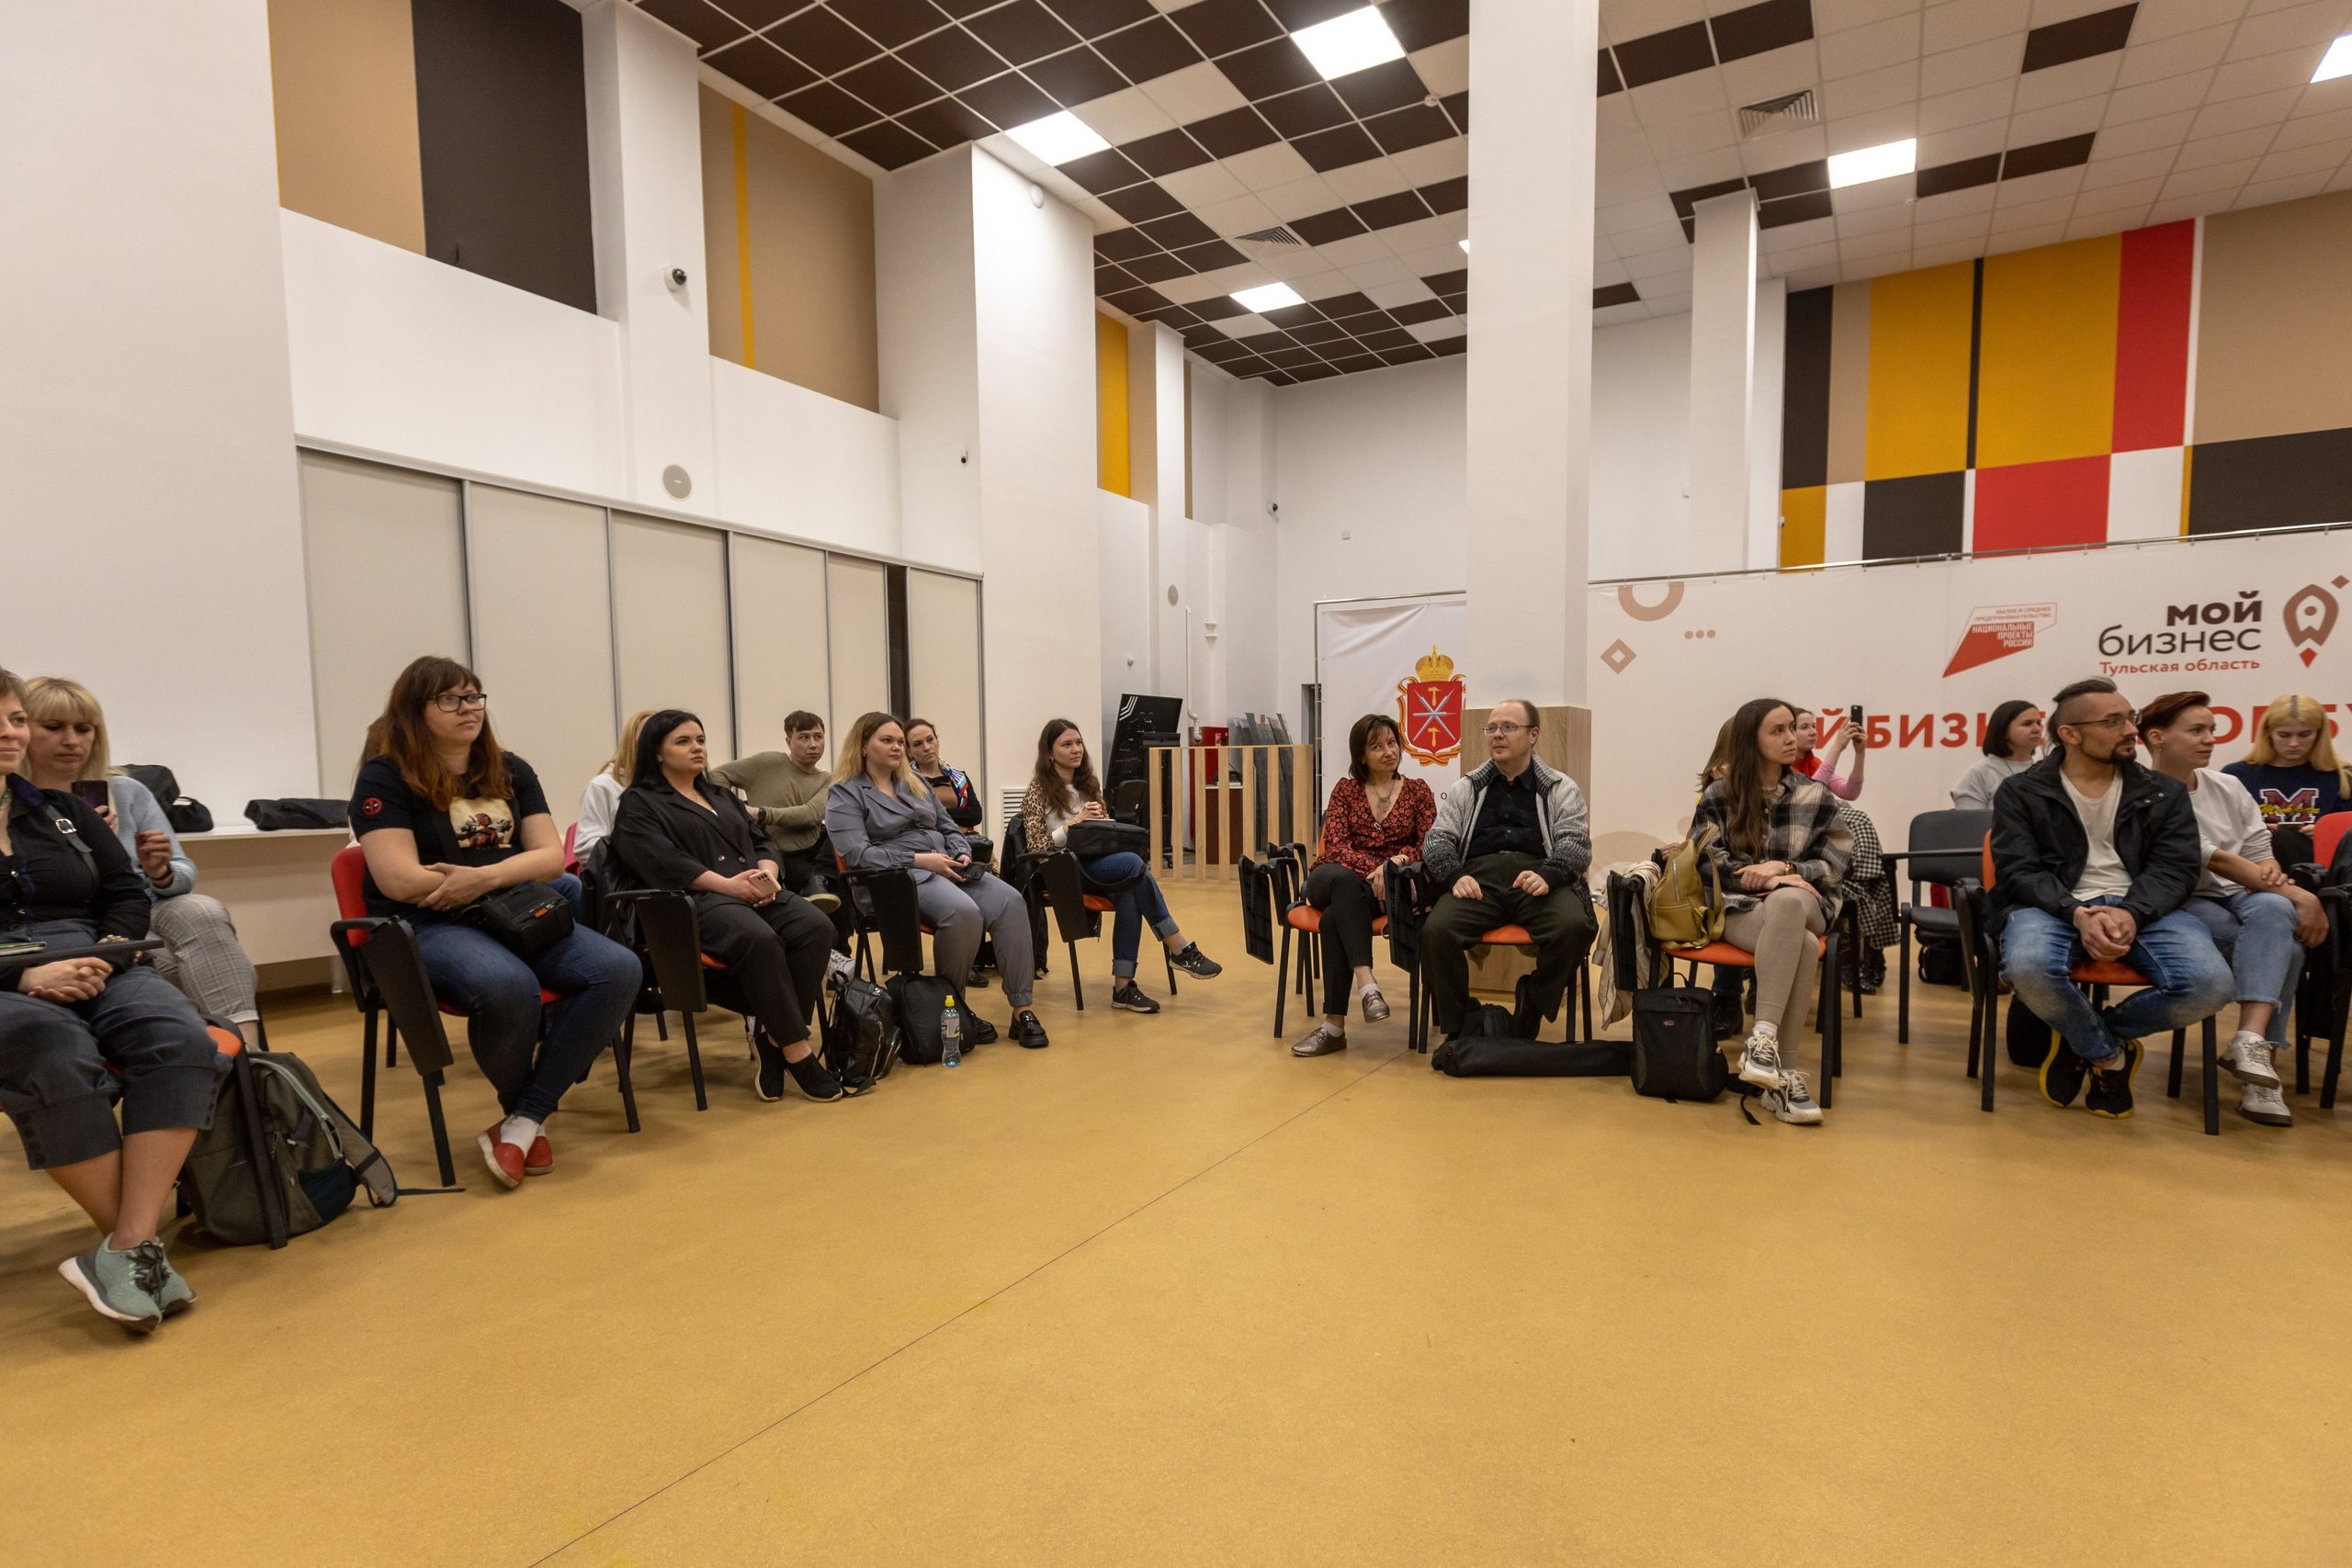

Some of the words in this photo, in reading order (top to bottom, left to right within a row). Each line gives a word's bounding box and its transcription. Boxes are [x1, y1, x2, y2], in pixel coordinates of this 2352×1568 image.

[2166, 590, 2263, 626] мой
[1973, 623, 2033, 634] НАЦИОНАЛЬНЫЕ
[1997, 631, 2033, 640] ПРОЕКТЫ
[2003, 639, 2032, 648] РОССИИ
[2098, 624, 2262, 657] бизнес
[2099, 661, 2179, 677] Тульская
[2185, 659, 2261, 671] область
[2259, 788, 2320, 824] M
